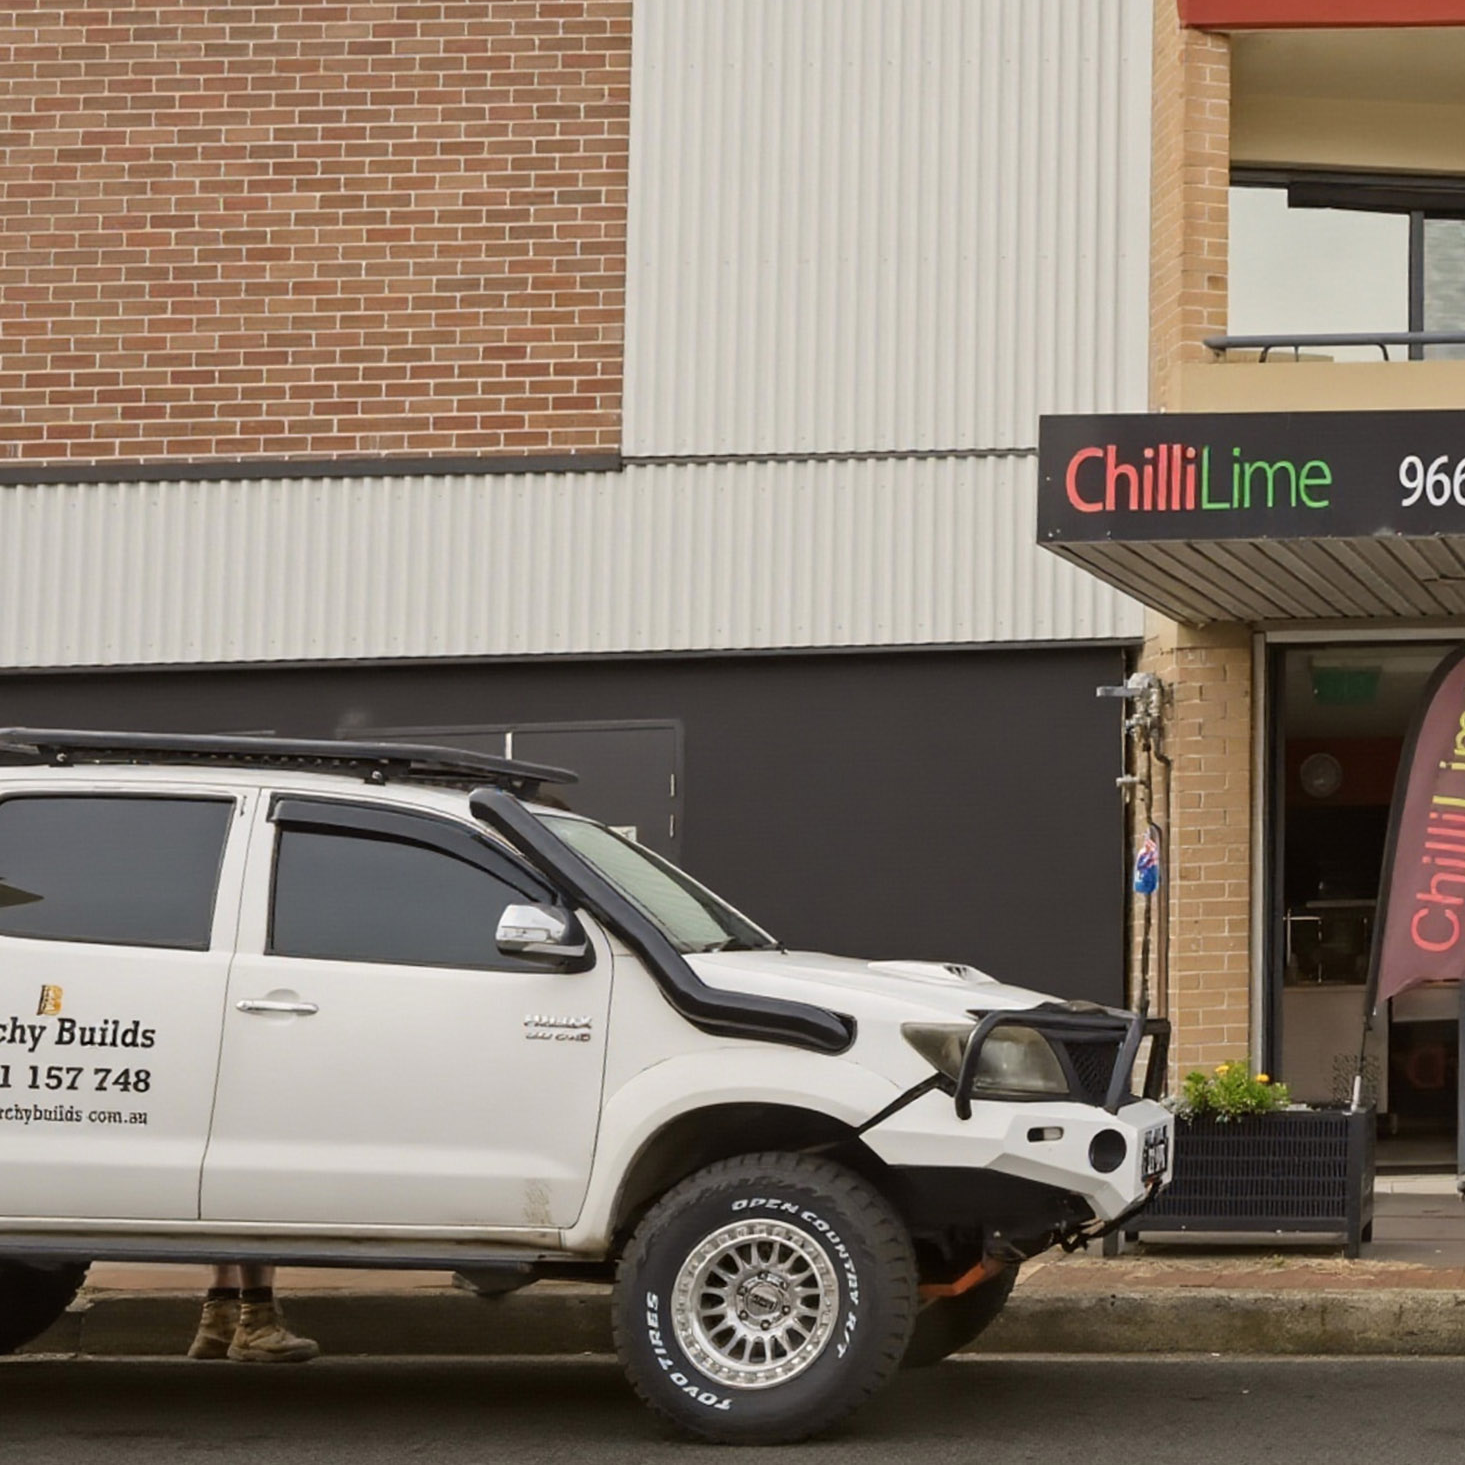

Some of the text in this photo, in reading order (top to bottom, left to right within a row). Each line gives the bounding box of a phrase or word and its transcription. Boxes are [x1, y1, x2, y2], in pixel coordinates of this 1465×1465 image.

[1064, 443, 1333, 513] ChilliLime
[54, 1017, 157, 1048] Builds
[27, 1065, 84, 1090] 157
[93, 1068, 152, 1093] 748
[731, 1197, 800, 1215] OPEN
[801, 1210, 860, 1306] COUNTRY
[646, 1291, 674, 1371] TIRES
